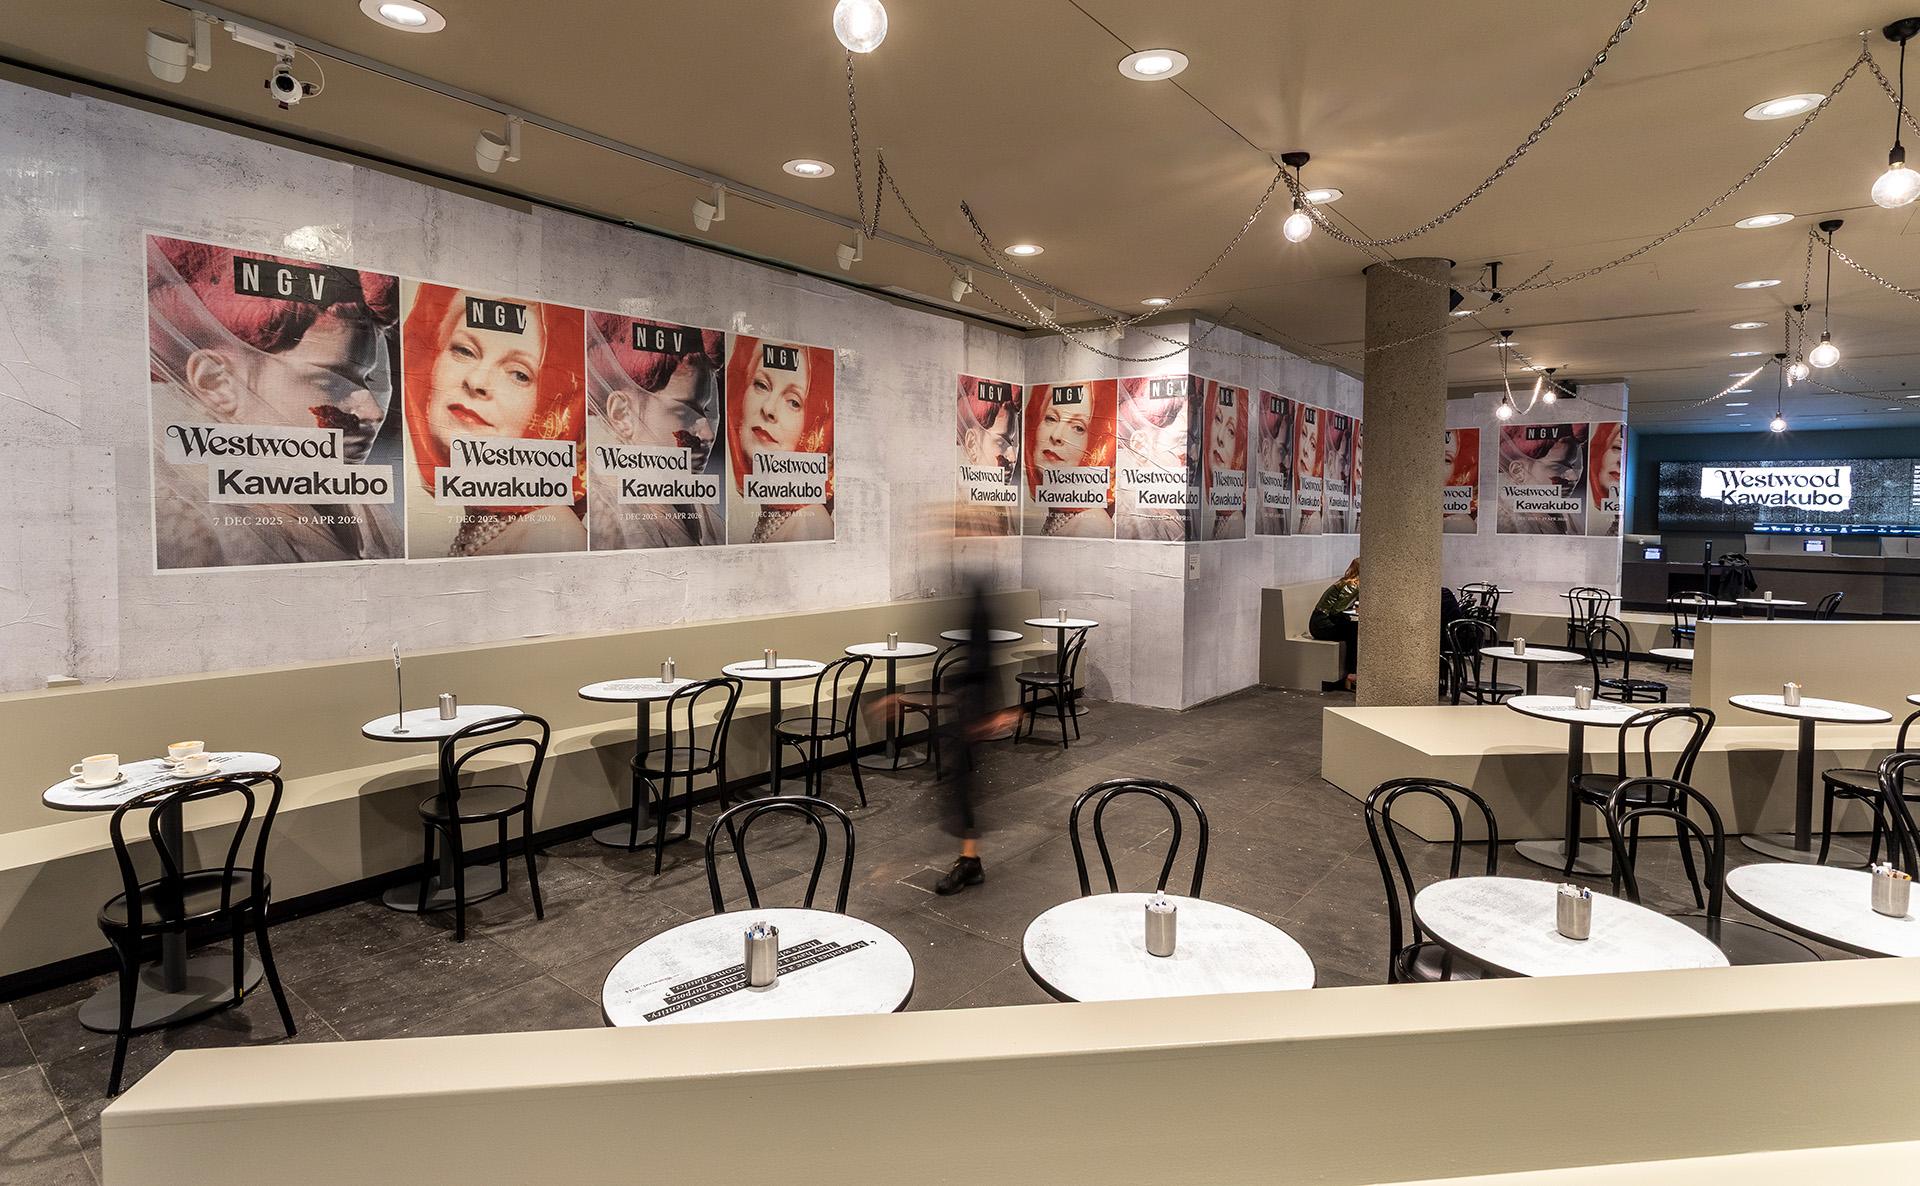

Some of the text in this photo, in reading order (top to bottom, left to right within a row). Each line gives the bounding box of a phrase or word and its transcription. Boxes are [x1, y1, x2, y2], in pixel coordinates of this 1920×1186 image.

[1527, 427, 1559, 439] NGV
[166, 425, 338, 459] Westwood
[452, 439, 575, 469] Westwood
[595, 446, 688, 471] Westwood
[754, 453, 827, 475] Westwood
[959, 465, 1004, 483] Westwood
[1045, 469, 1109, 484] Westwood
[1122, 469, 1189, 485] Westwood
[1714, 468, 1839, 489] Westwood
[218, 469, 388, 495] Kawakubo
[442, 475, 568, 498] Kawakubo
[622, 479, 716, 499] Kawakubo
[747, 480, 822, 498] Kawakubo
[970, 488, 1017, 503] Kawakubo
[1039, 490, 1104, 504] Kawakubo
[1139, 490, 1199, 505] Kawakubo
[1443, 487, 1471, 497] wood
[1503, 486, 1559, 497] Westwood
[1721, 489, 1843, 506] Kawakubo
[1516, 500, 1579, 511] Kawakubo
[213, 517, 220, 526] 7
[224, 516, 251, 526] DEC
[255, 516, 283, 526] 2025
[298, 515, 308, 524] 19
[311, 515, 335, 525] APR
[337, 515, 363, 525] 2026
[456, 515, 475, 524] DEC
[477, 515, 498, 523] 2025
[719, 975, 739, 986] and
[693, 996, 708, 1004] an
[709, 986, 734, 999] have
[647, 1001, 691, 1020] identity.
